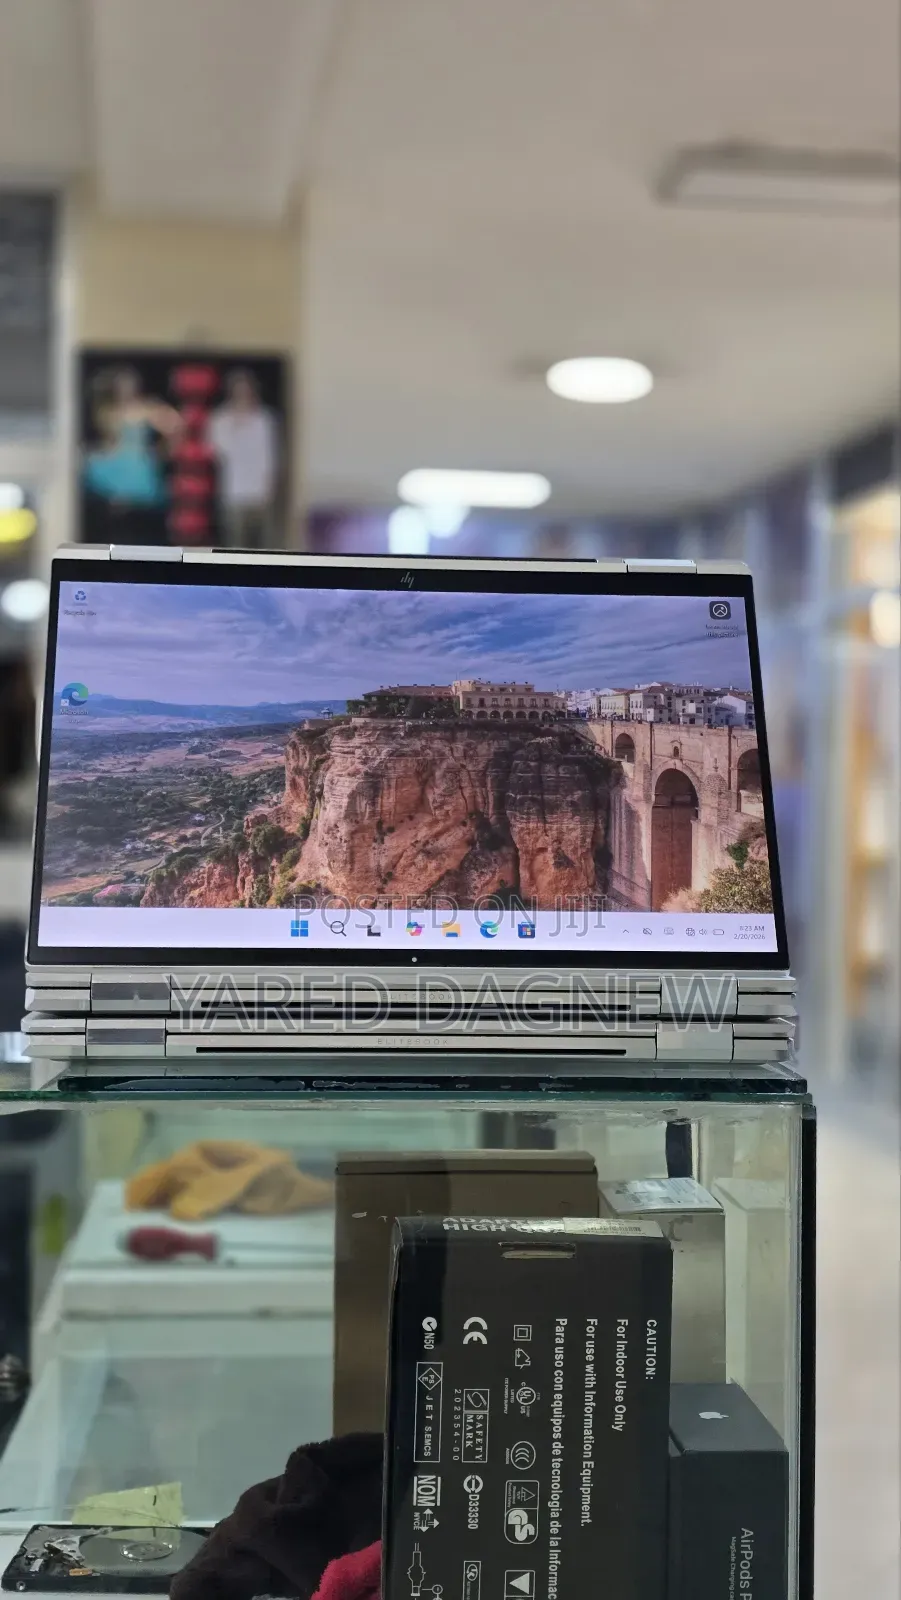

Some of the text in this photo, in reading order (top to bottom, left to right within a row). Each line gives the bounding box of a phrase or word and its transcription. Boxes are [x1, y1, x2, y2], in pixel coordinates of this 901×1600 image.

[377, 1037, 449, 1046] ELITEBOOK
[442, 1223, 507, 1232] HIGH
[423, 1332, 435, 1350] N50
[463, 1317, 488, 1344] CE
[555, 1318, 568, 1344] Para
[554, 1347, 564, 1367] uso
[646, 1319, 657, 1380] CAUTION:
[554, 1370, 563, 1391] con
[612, 1319, 629, 1432] For Indoor Use Only
[453, 1389, 461, 1461] 202354-00
[465, 1414, 474, 1448] MARK
[550, 1393, 565, 1439] equipos
[580, 1318, 598, 1527] For use with Information Equipment.
[475, 1414, 484, 1460] SAFETY
[552, 1442, 564, 1456] de
[417, 1475, 436, 1506] NOM
[548, 1458, 563, 1518] tecnologia
[467, 1494, 480, 1530] D33330
[549, 1521, 562, 1534] de
[549, 1537, 562, 1547] la
[740, 1527, 754, 1589] AirPods
